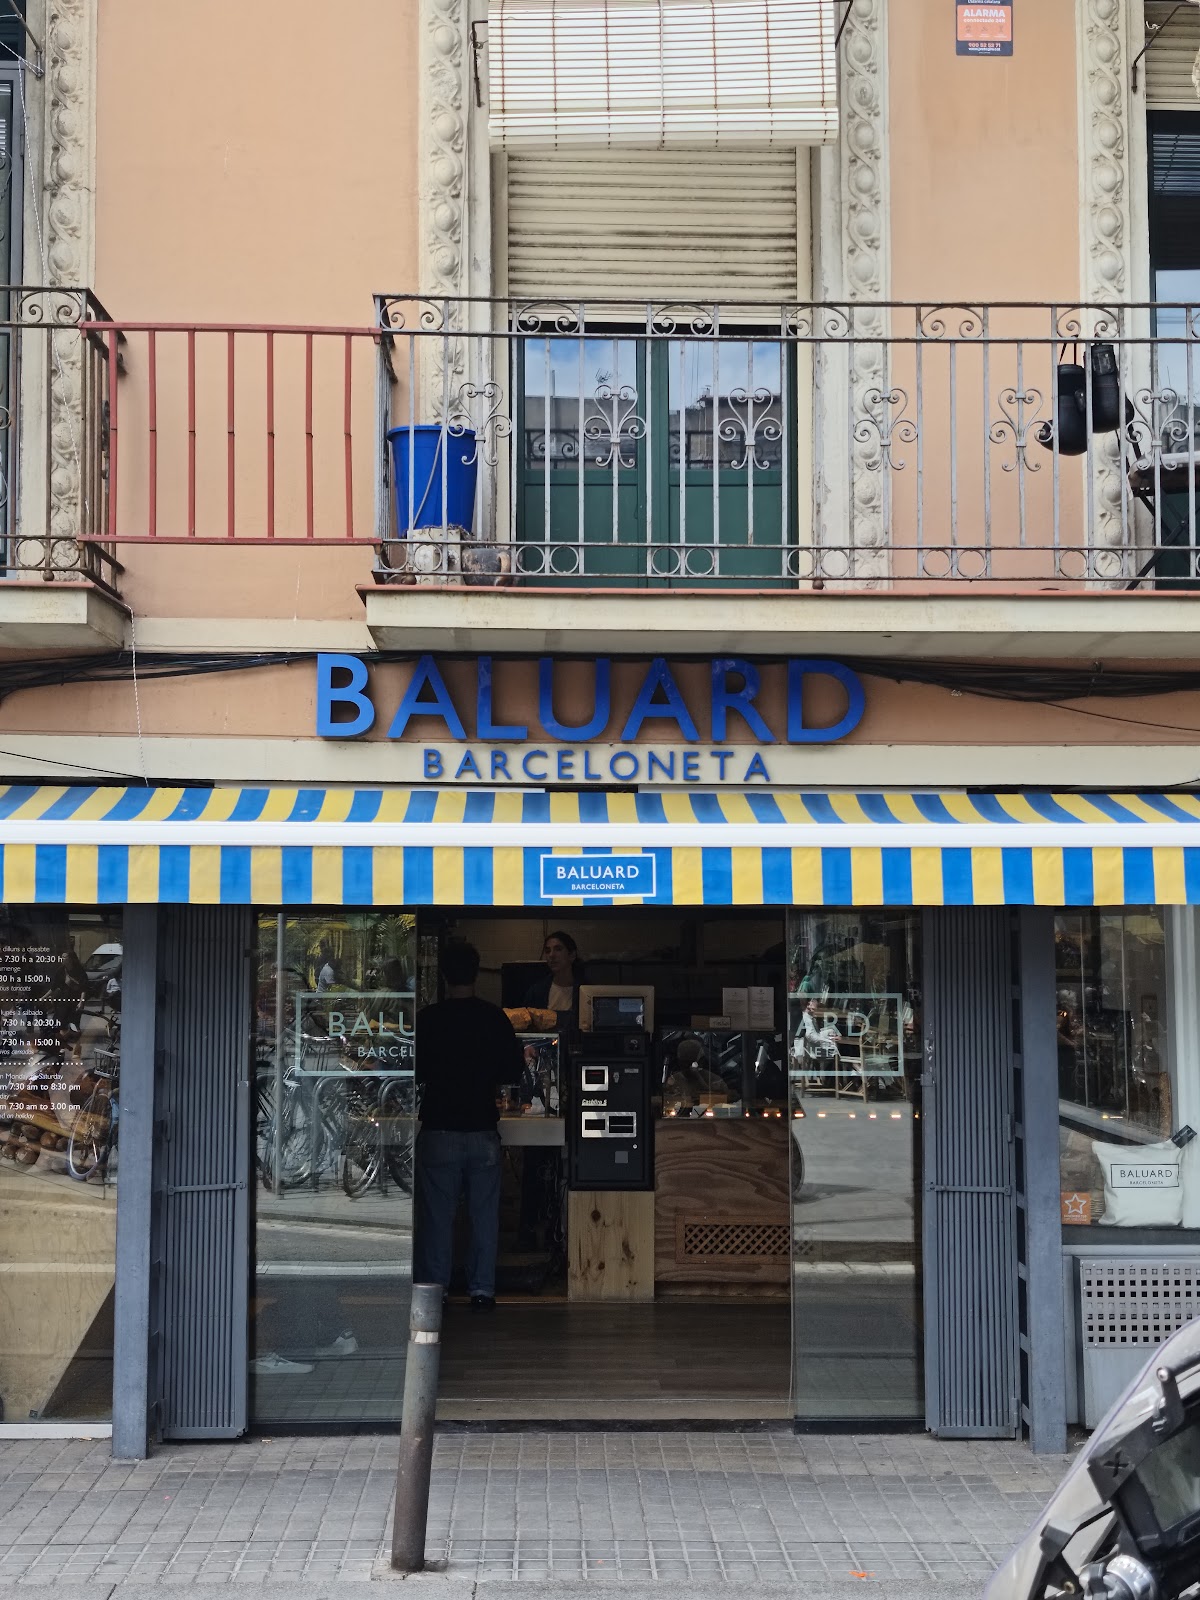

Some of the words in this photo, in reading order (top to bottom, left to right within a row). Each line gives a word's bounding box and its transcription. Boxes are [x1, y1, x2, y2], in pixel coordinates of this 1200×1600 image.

[963, 9, 1006, 18] ALARMA
[316, 652, 866, 743] BALUARD
[423, 748, 772, 782] BARCELONETA
[556, 865, 640, 879] BALUARD
[571, 883, 625, 891] BARCELONETA
[5, 955, 20, 963] 7:30
[22, 955, 27, 963] h
[36, 955, 56, 963] 20:30
[58, 955, 63, 963] h
[788, 1012, 869, 1037] ARD
[2, 1038, 17, 1046] 7:30
[20, 1038, 24, 1046] h
[34, 1038, 53, 1046] 15:00
[55, 1038, 60, 1046] h
[9, 1083, 25, 1091] 7:30
[50, 1083, 67, 1091] 8:30
[68, 1084, 81, 1092] pm
[9, 1102, 24, 1110] 7:30
[50, 1102, 67, 1110] 3.00
[68, 1104, 81, 1112] pm
[1119, 1169, 1173, 1178] BALUARD
